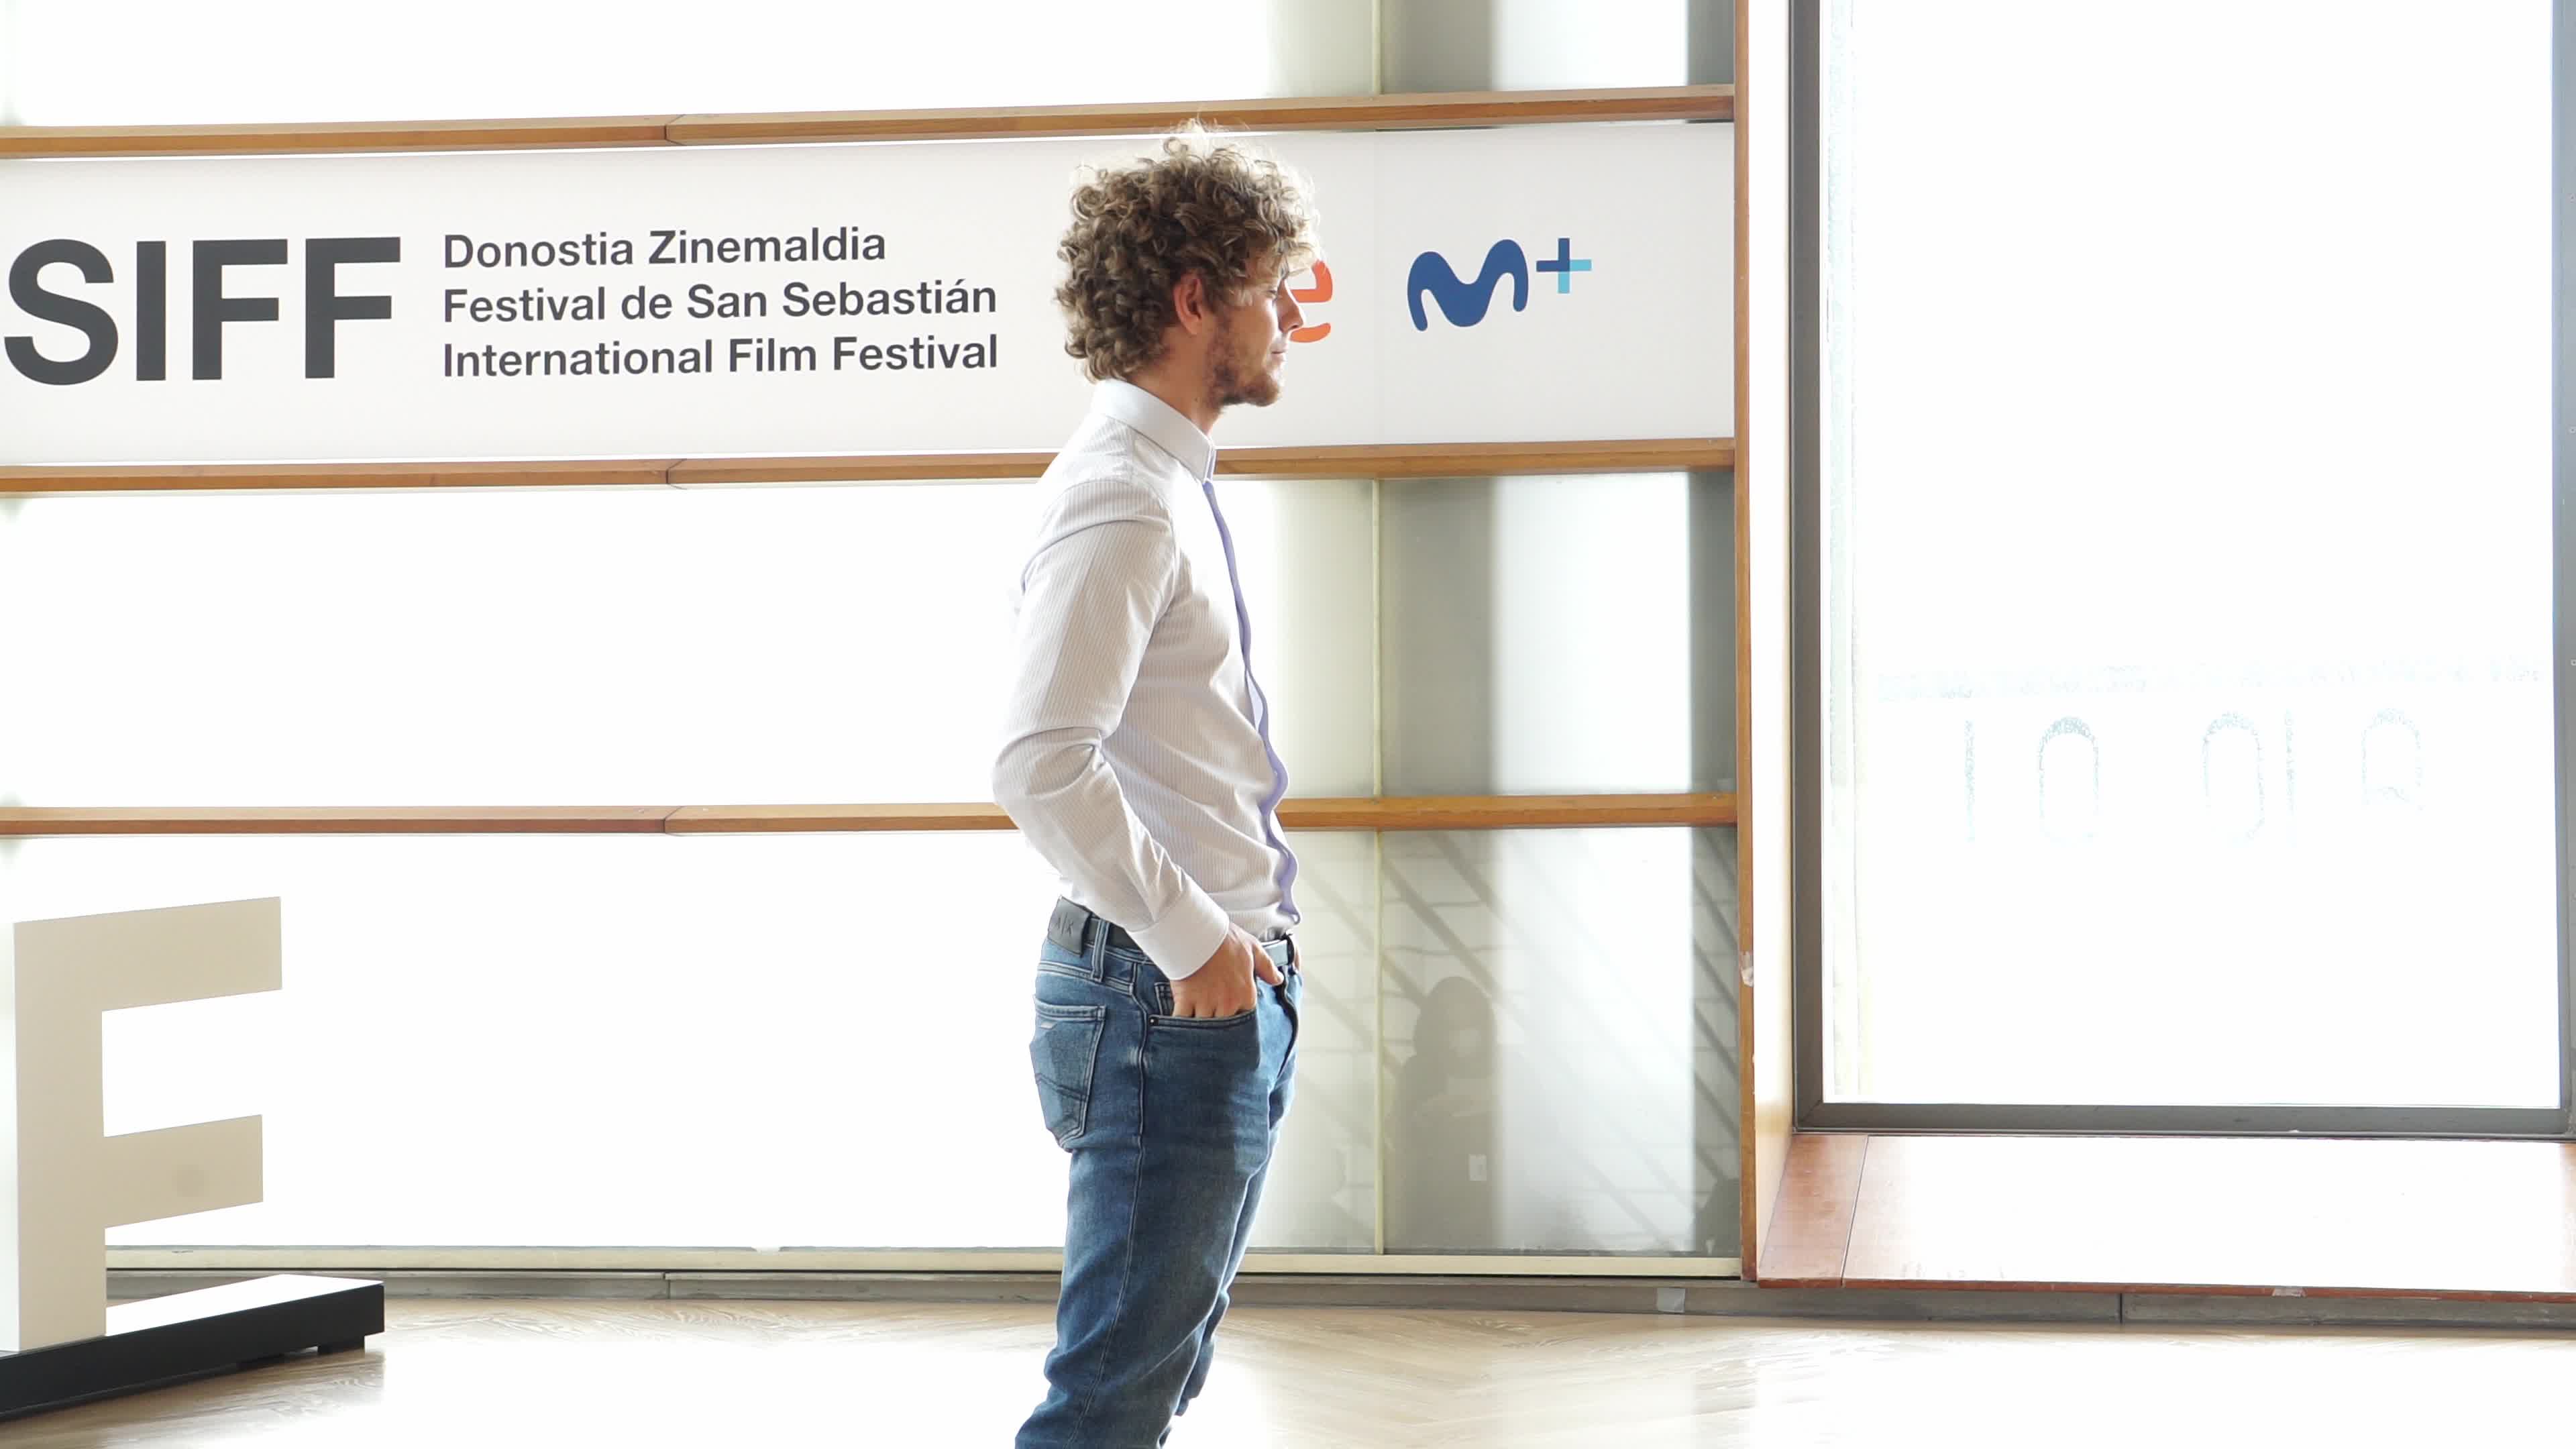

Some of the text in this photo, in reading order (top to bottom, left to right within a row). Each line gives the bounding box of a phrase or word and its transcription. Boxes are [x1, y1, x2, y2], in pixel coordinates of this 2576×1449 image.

[445, 226, 885, 268] Donostia Zinemaldia
[4, 236, 401, 386] SIFF
[445, 278, 996, 323] Festival de San Sebastián
[445, 333, 997, 377] International Film Festival
